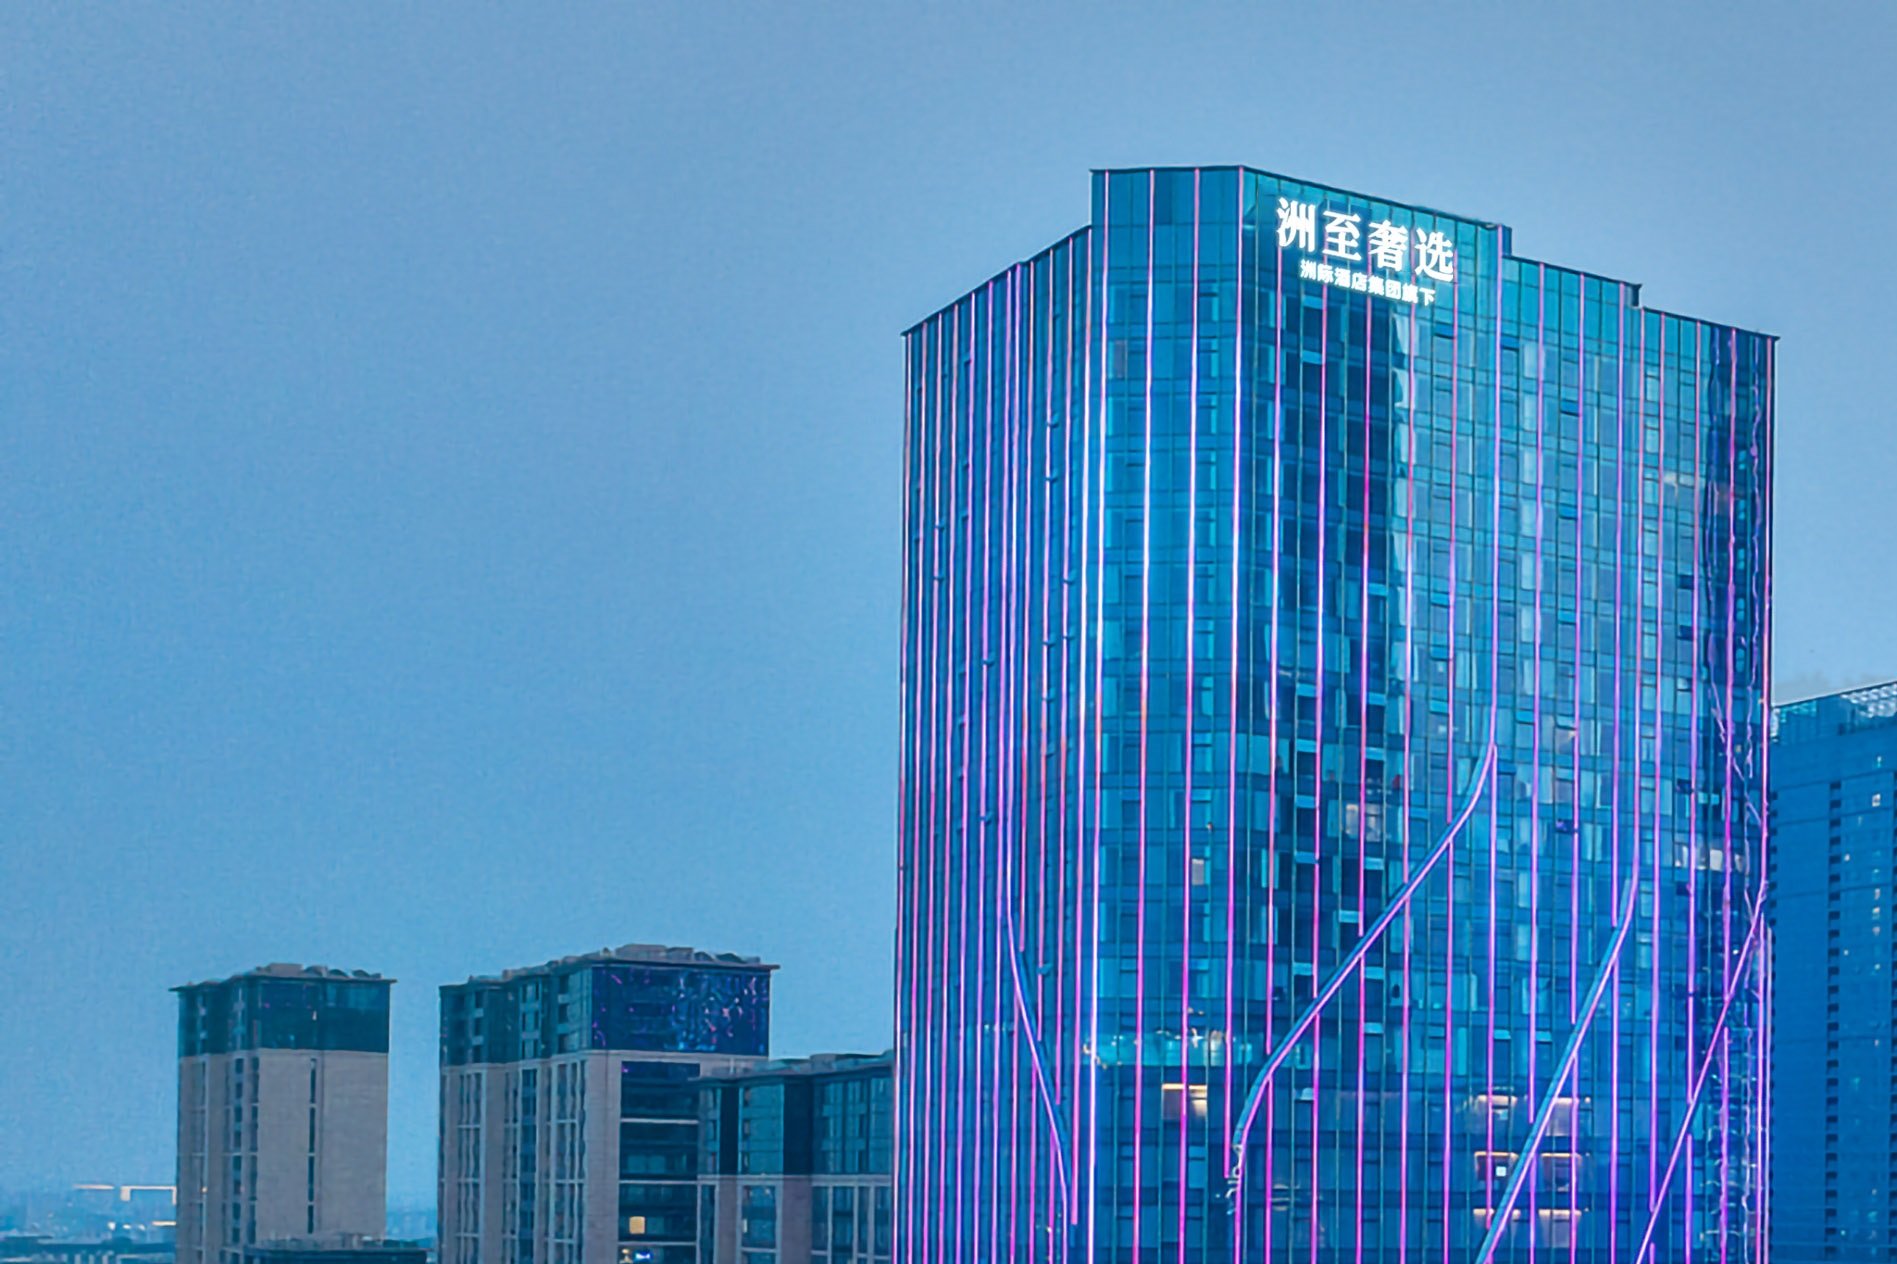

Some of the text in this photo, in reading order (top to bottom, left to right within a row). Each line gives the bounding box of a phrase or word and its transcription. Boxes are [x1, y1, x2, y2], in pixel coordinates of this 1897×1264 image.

[1277, 197, 1454, 282] 洲至奢选
[1299, 259, 1436, 306] 洲际酒店集团旗下
